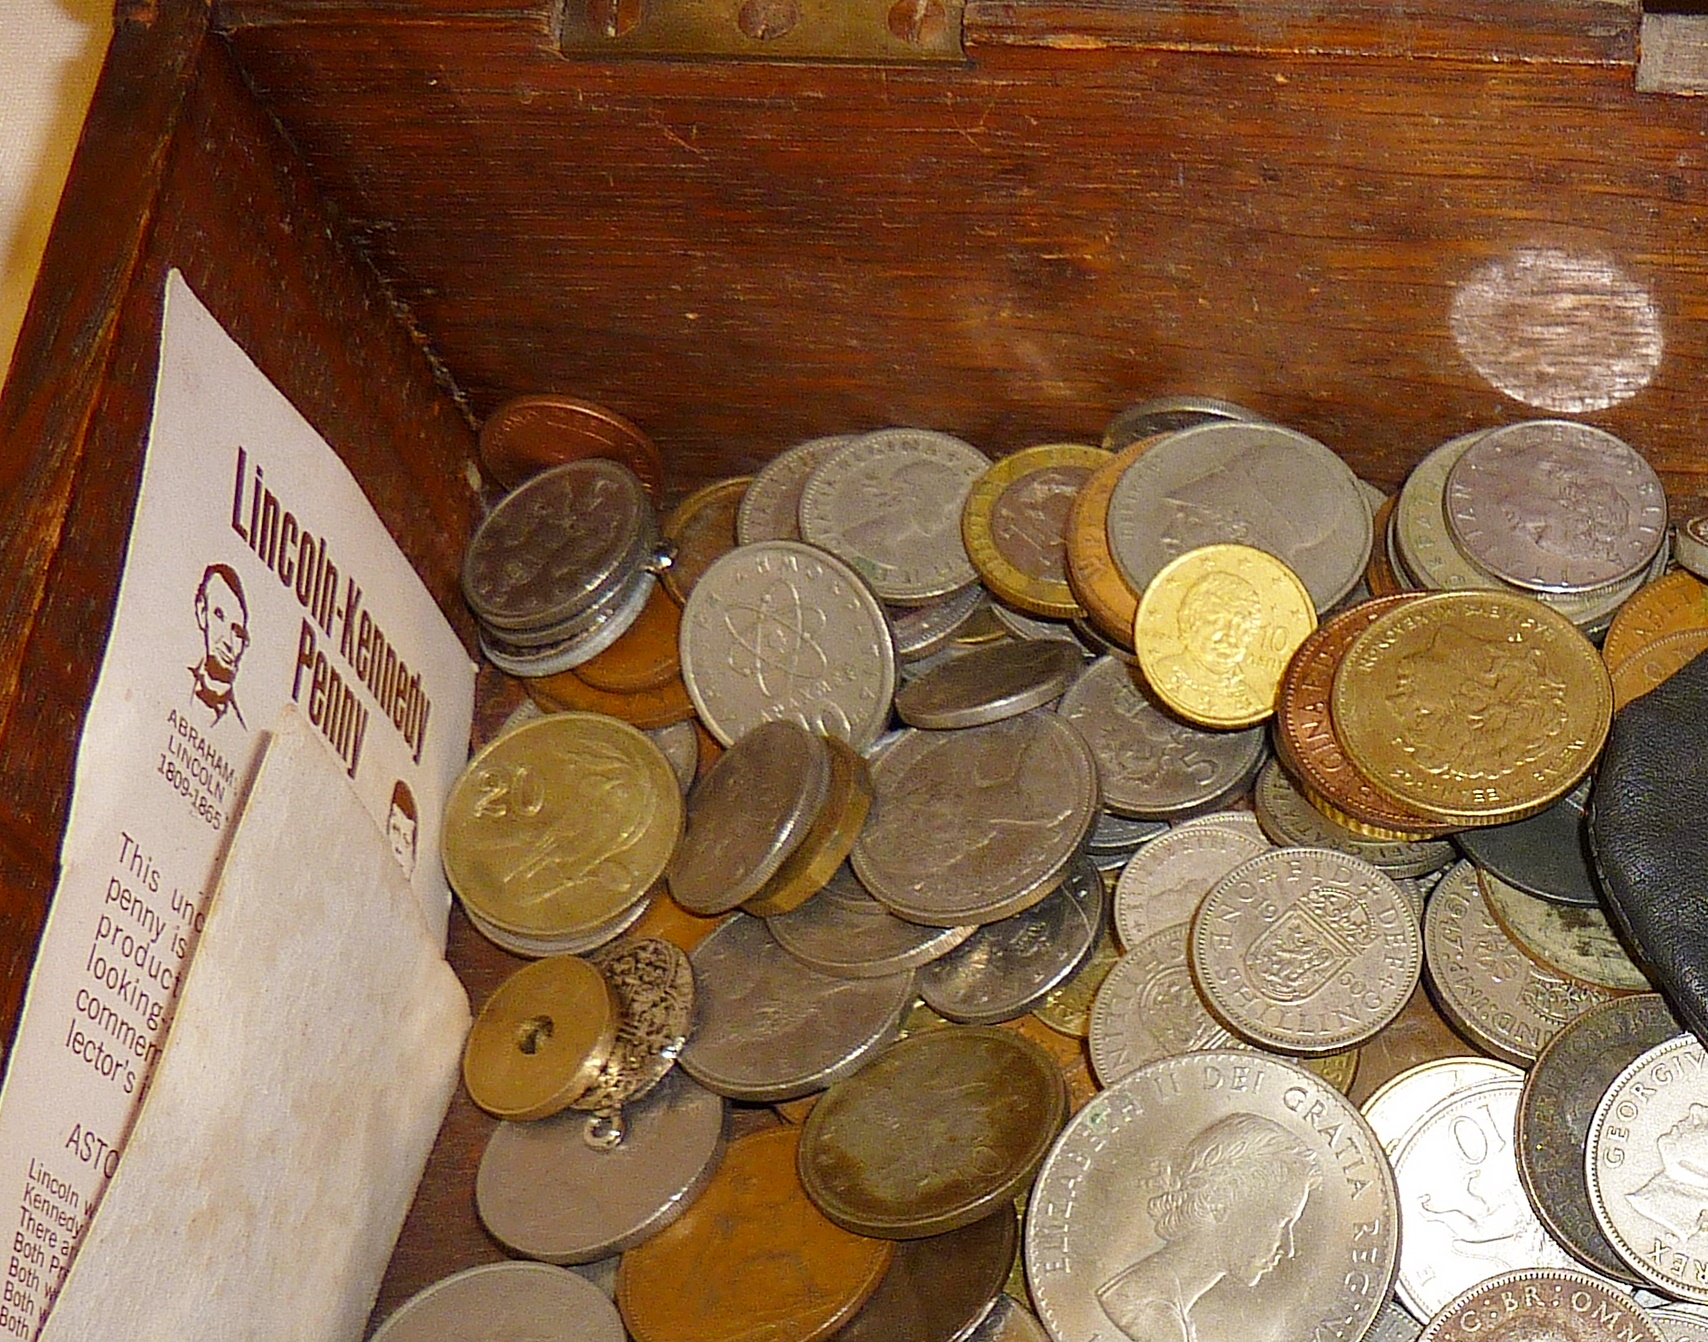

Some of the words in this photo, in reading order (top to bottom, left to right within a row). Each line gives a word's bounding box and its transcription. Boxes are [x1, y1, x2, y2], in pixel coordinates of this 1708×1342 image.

[232, 445, 431, 765] Lincoln-Kennedy
[293, 617, 370, 779] Penny
[167, 709, 235, 786] ABRAHAM
[168, 735, 225, 803] LINCOLN
[157, 753, 222, 830] 1809-1865
[120, 831, 160, 892] This
[105, 875, 166, 944] penny
[171, 925, 188, 959] is
[65, 1018, 136, 1094] lector's
[1157, 1070, 1181, 1097] II
[1203, 1067, 1262, 1093] DEI
[1283, 1087, 1374, 1199] GRATIA
[23, 1182, 84, 1239] Kennedy
[28, 1157, 80, 1208] Lincoln
[13, 1231, 45, 1268] Both
[20, 1206, 58, 1249] There
[4, 1280, 35, 1316] Both
[8, 1256, 40, 1292] Both
